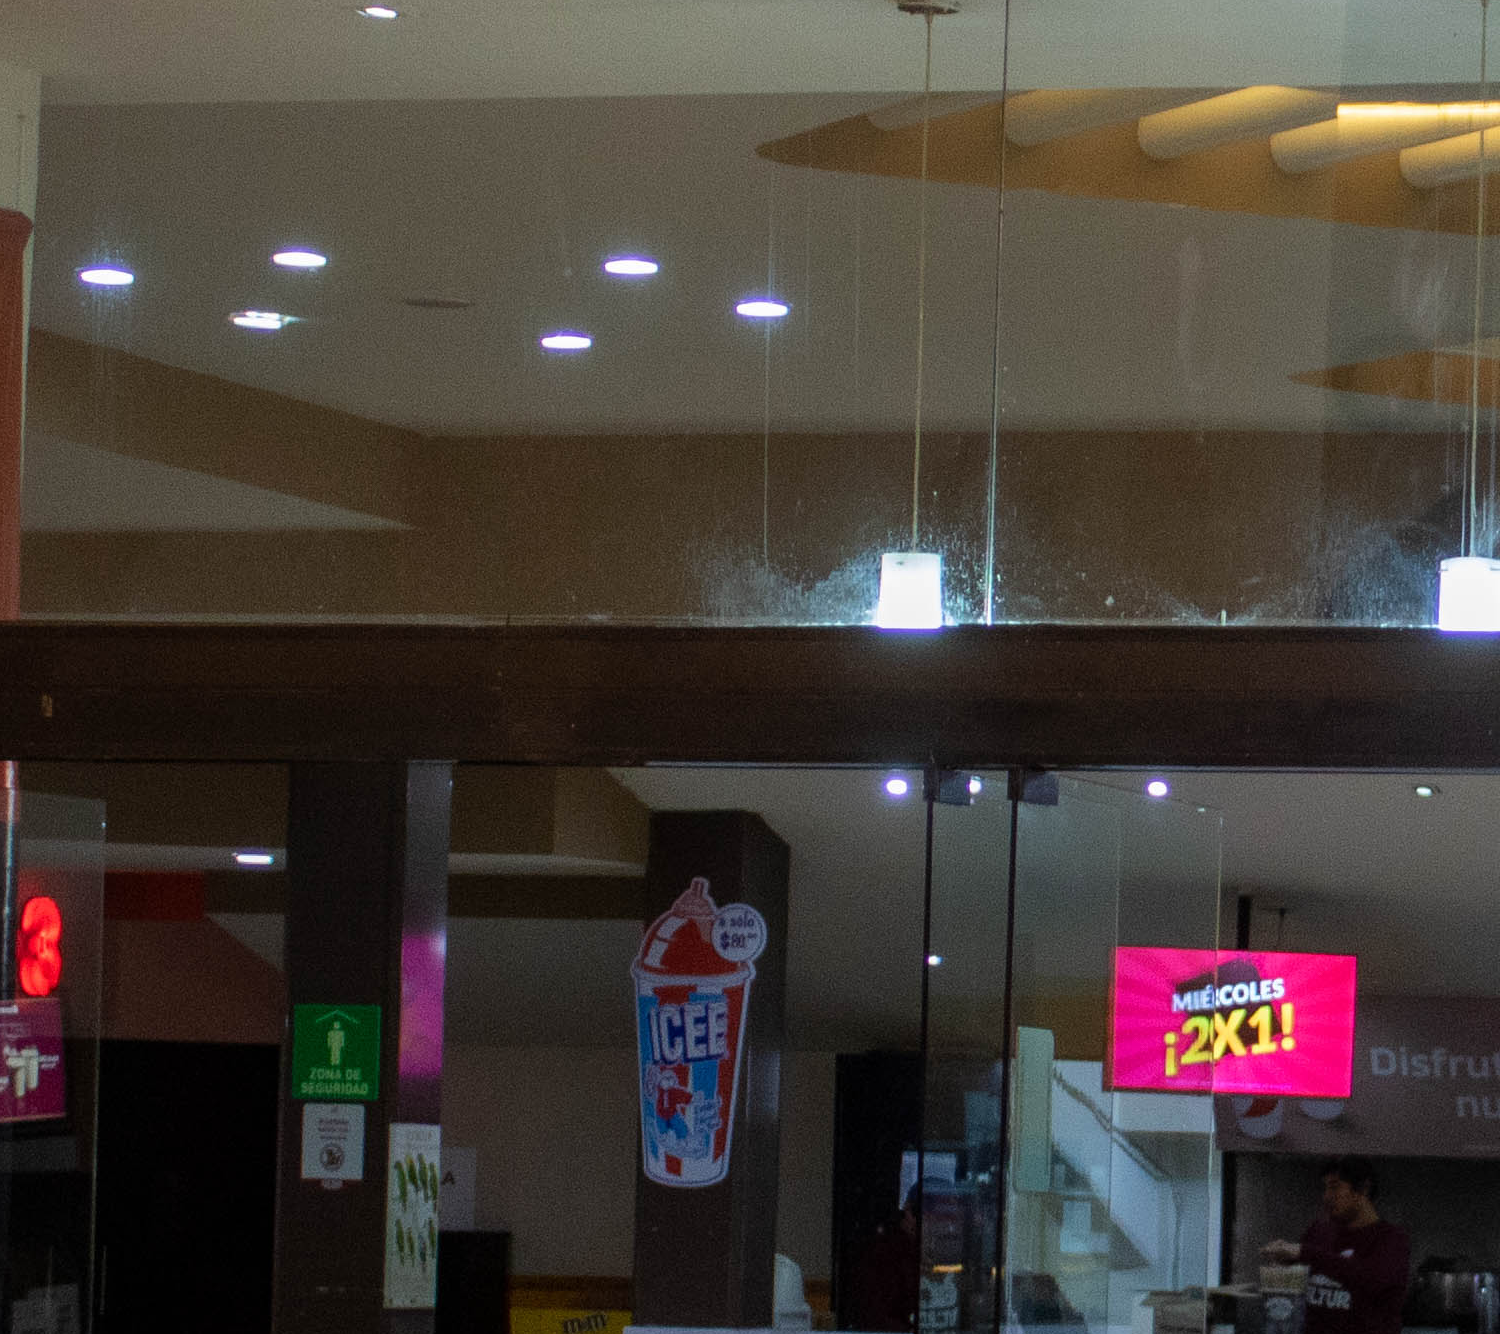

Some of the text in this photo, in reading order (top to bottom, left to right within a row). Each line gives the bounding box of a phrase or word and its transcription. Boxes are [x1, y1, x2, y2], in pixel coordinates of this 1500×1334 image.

[649, 1002, 728, 1065] ICEE
[1164, 1002, 1296, 1078] ¡2X1!
[300, 1082, 369, 1095] SEGURIDAD
[309, 1068, 362, 1080] ZONA DE
